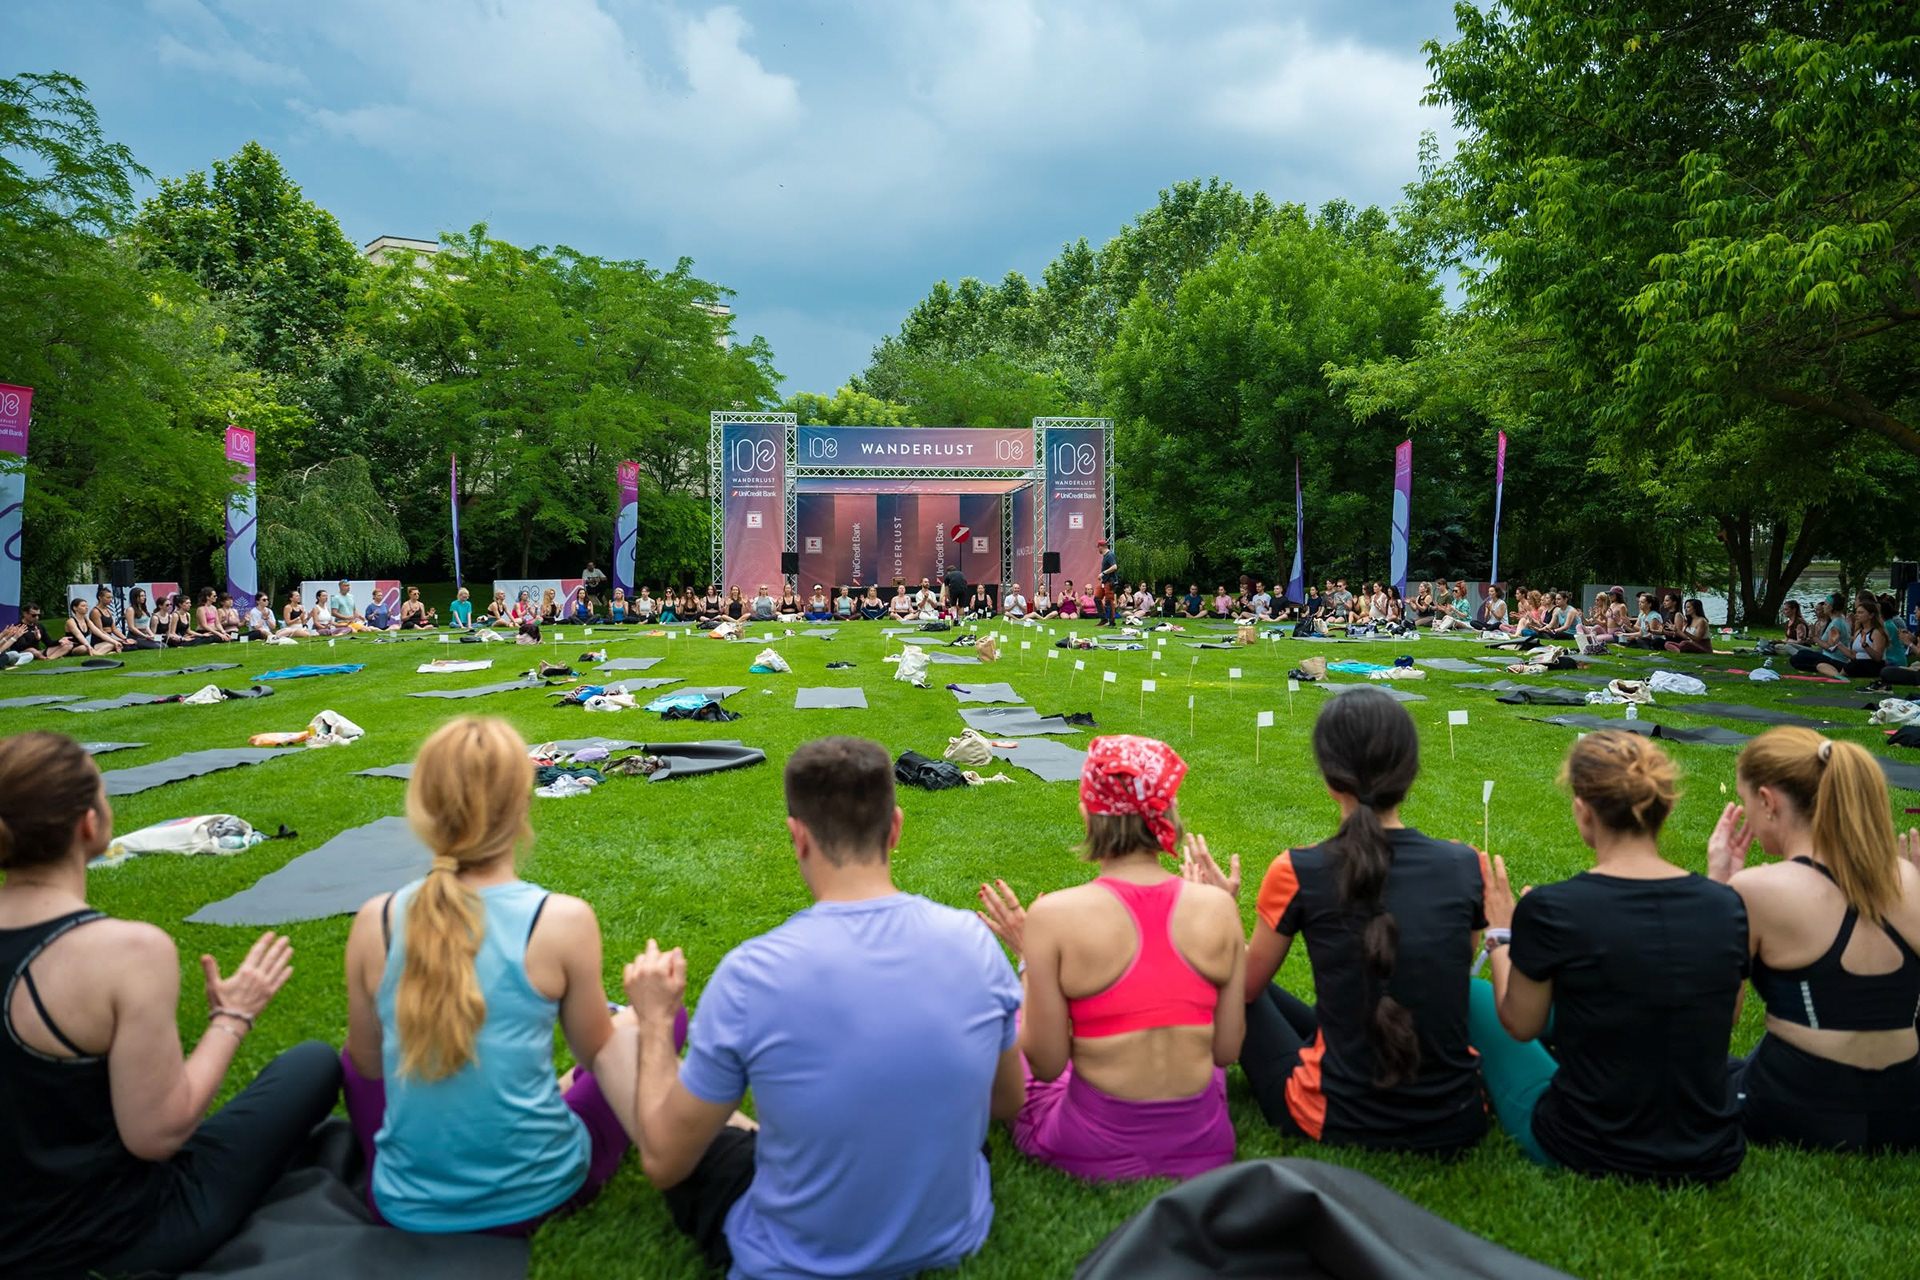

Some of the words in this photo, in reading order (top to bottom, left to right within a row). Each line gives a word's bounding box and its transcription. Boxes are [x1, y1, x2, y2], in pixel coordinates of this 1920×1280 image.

[231, 433, 250, 452] 108
[809, 437, 838, 458] 108
[861, 443, 974, 455] WANDERLUST
[995, 440, 1024, 460] 108
[731, 439, 776, 472] 108
[1053, 443, 1096, 475] 108
[852, 522, 860, 542] Bank
[936, 522, 944, 542] Bank
[893, 516, 902, 577] NDERLUST
[852, 543, 860, 577] UniCredit
[936, 543, 944, 576] UniCredit
